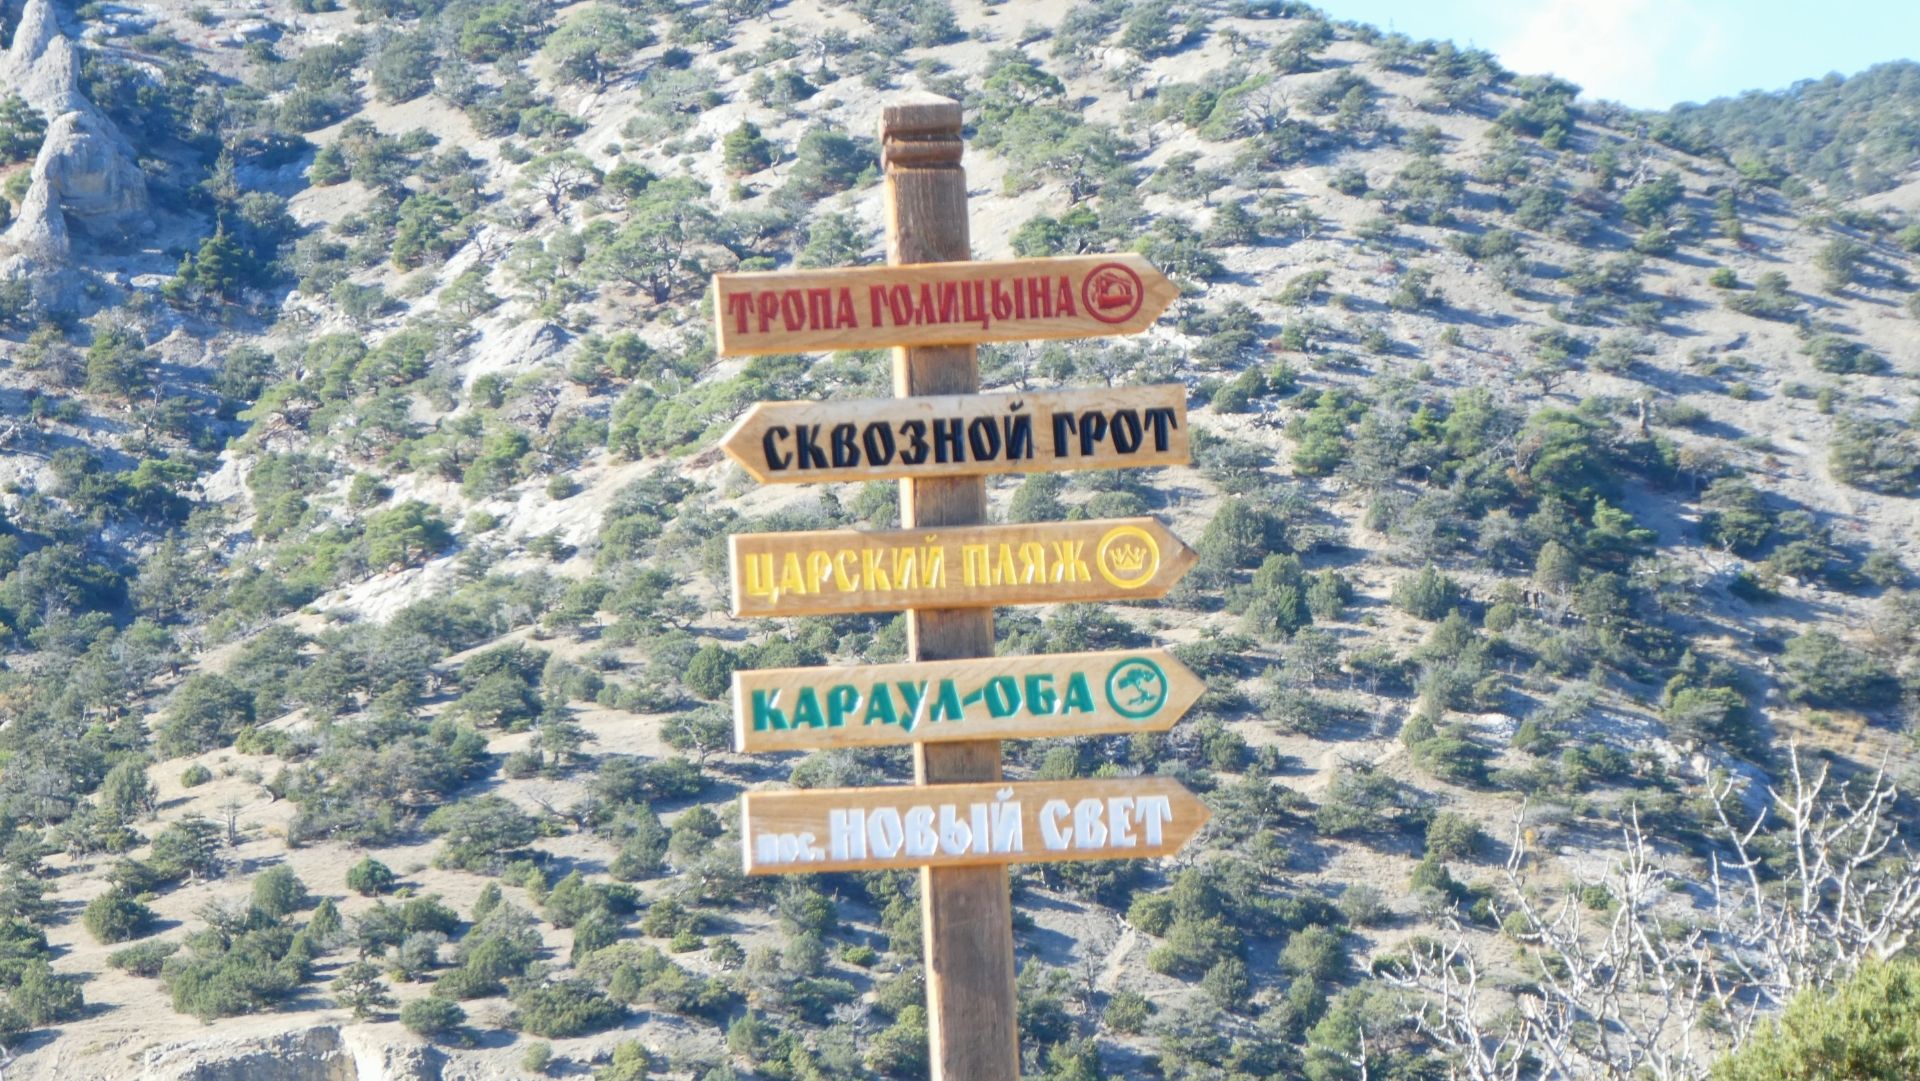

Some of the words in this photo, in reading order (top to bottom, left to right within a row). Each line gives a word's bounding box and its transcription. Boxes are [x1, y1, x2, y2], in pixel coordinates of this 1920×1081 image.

[728, 287, 858, 334] ТРОПА
[870, 275, 1077, 330] ГОЛИЦЫНА
[762, 400, 1034, 471] СКВОЗНОЙ
[1052, 407, 1178, 458] ГРОТ
[745, 534, 946, 604] ЦАРСКИЙ
[962, 539, 1091, 587] ПЛЯЖ
[752, 671, 1096, 733] КАРАУЛ-ОБА
[829, 786, 1024, 859] НОВЫЙ
[1039, 795, 1172, 851] СВЕТ
